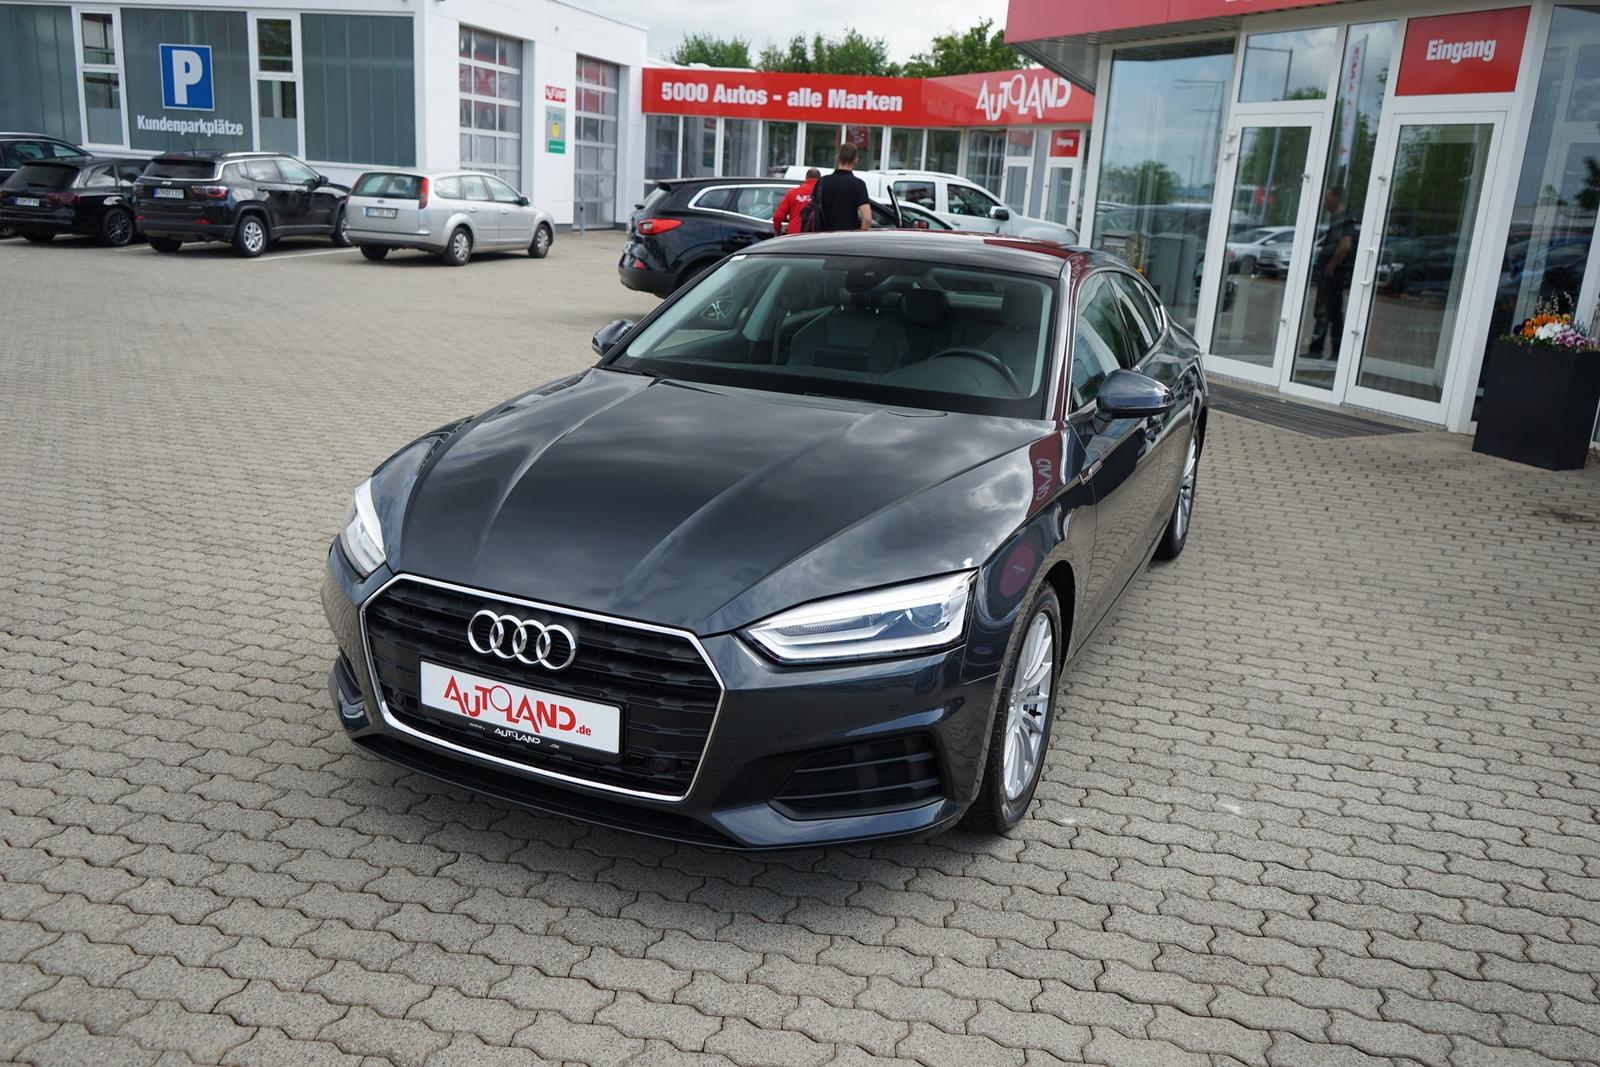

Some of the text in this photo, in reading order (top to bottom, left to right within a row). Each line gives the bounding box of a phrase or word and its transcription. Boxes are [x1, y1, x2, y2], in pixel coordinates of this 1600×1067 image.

[1425, 39, 1497, 64] Eingang
[172, 49, 203, 105] P
[661, 82, 709, 102] 5000
[713, 84, 768, 106] Autos
[787, 87, 822, 108] alle
[828, 89, 903, 112] Marken
[137, 115, 244, 137] Kundenparkplätze
